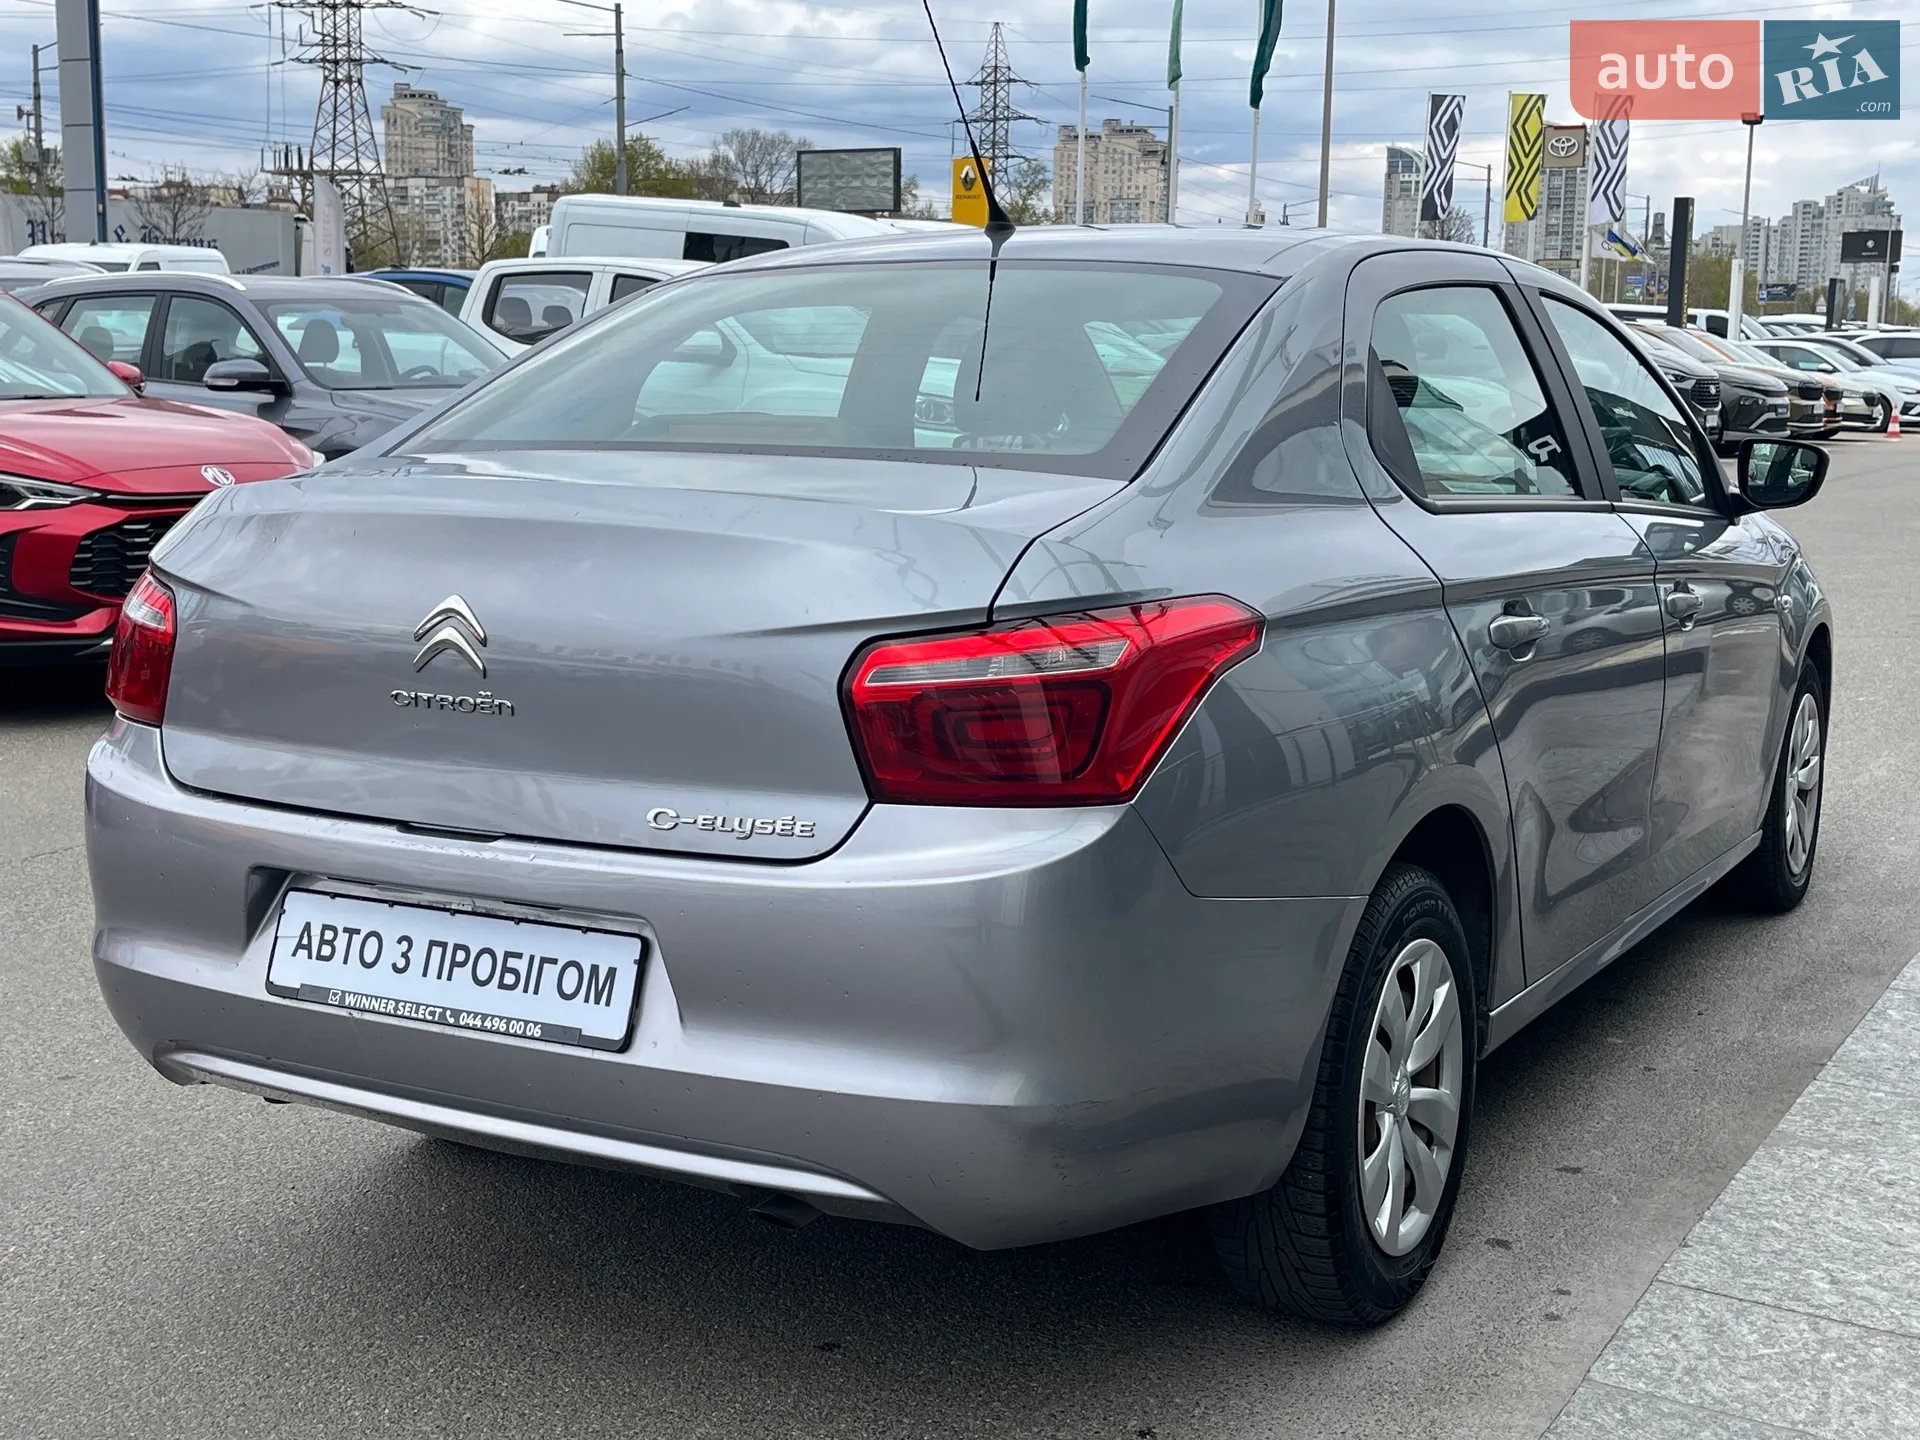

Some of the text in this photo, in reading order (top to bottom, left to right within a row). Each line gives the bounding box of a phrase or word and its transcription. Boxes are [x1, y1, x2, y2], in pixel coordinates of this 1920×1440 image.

[390, 690, 515, 717] CITROËN
[291, 920, 384, 970] АВТО
[422, 939, 618, 1008] ПРОБІГОМ
[344, 992, 542, 1037] WINNER SELECT 044 496 00 06
